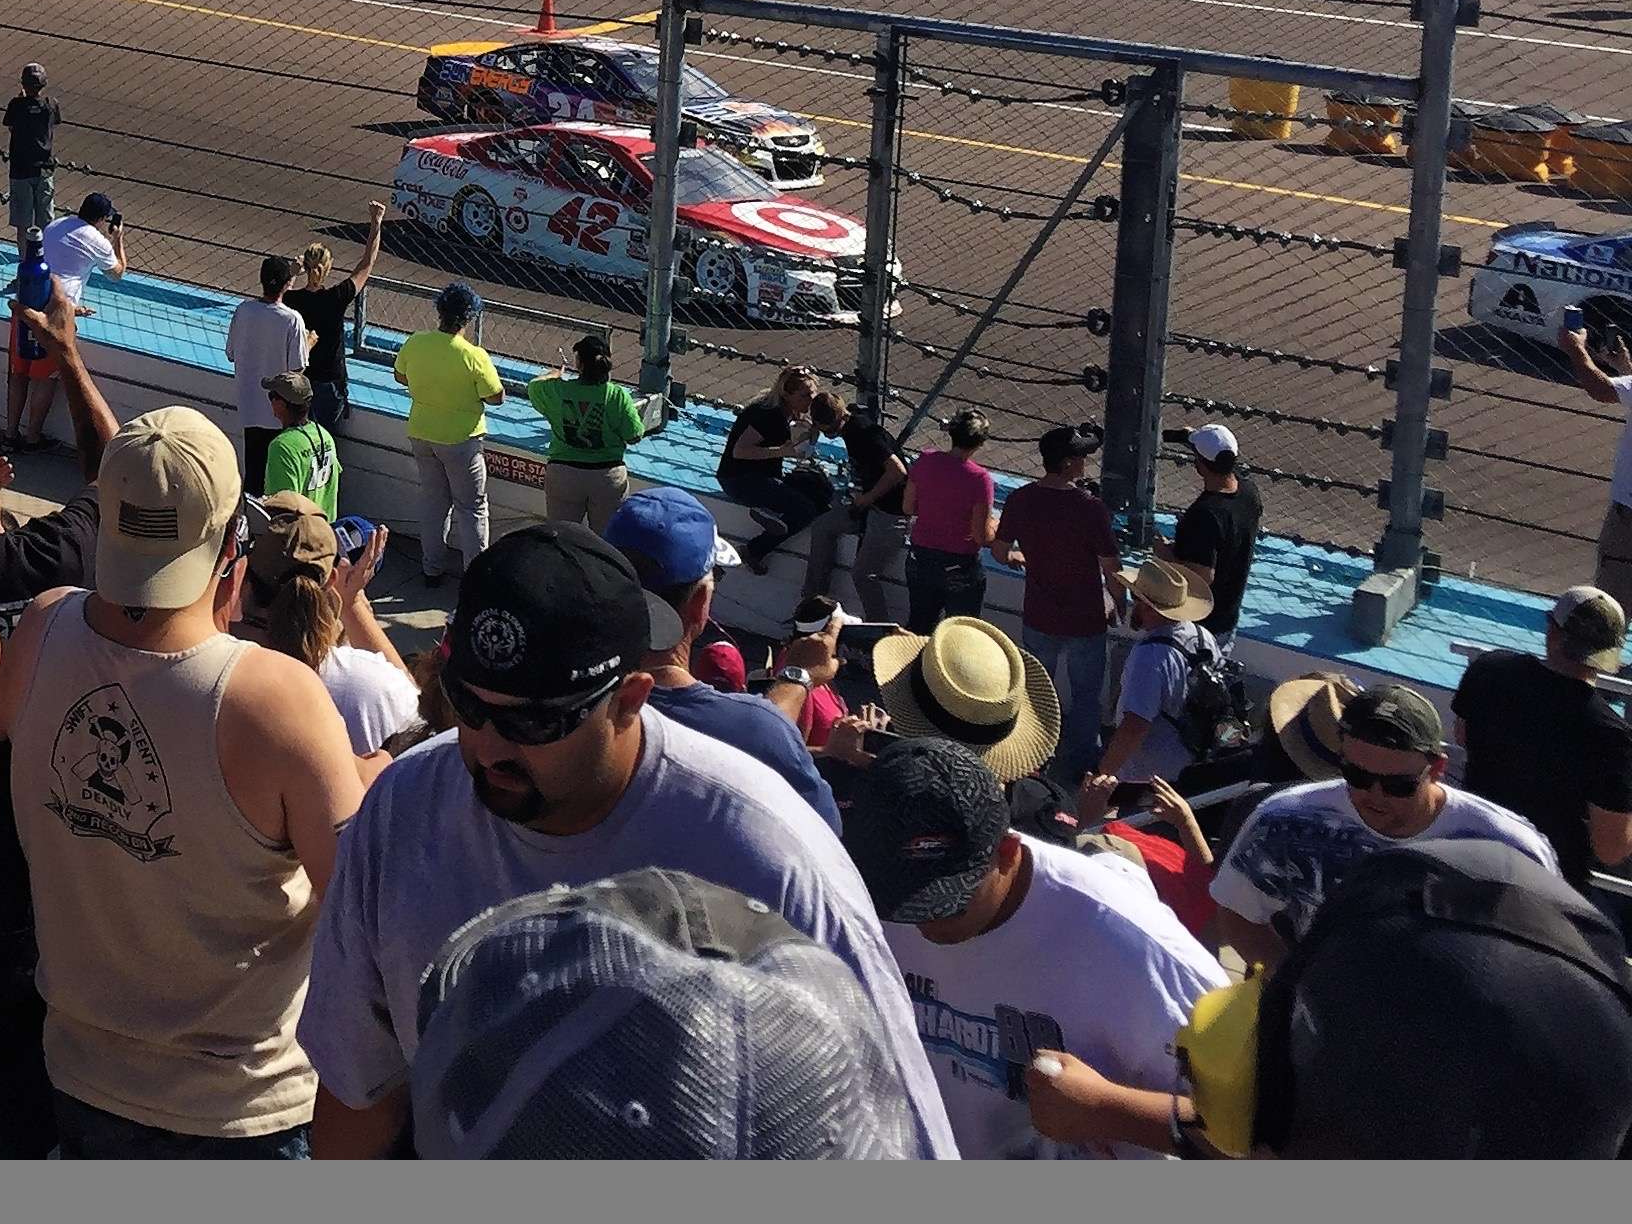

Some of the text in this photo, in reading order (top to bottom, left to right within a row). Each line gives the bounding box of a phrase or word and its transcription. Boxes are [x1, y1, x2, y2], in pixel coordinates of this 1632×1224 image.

[548, 195, 622, 257] 42
[511, 458, 527, 471] OR
[65, 700, 94, 735] SWIFT
[129, 718, 156, 767] SILENT
[82, 788, 132, 821] DEADLY
